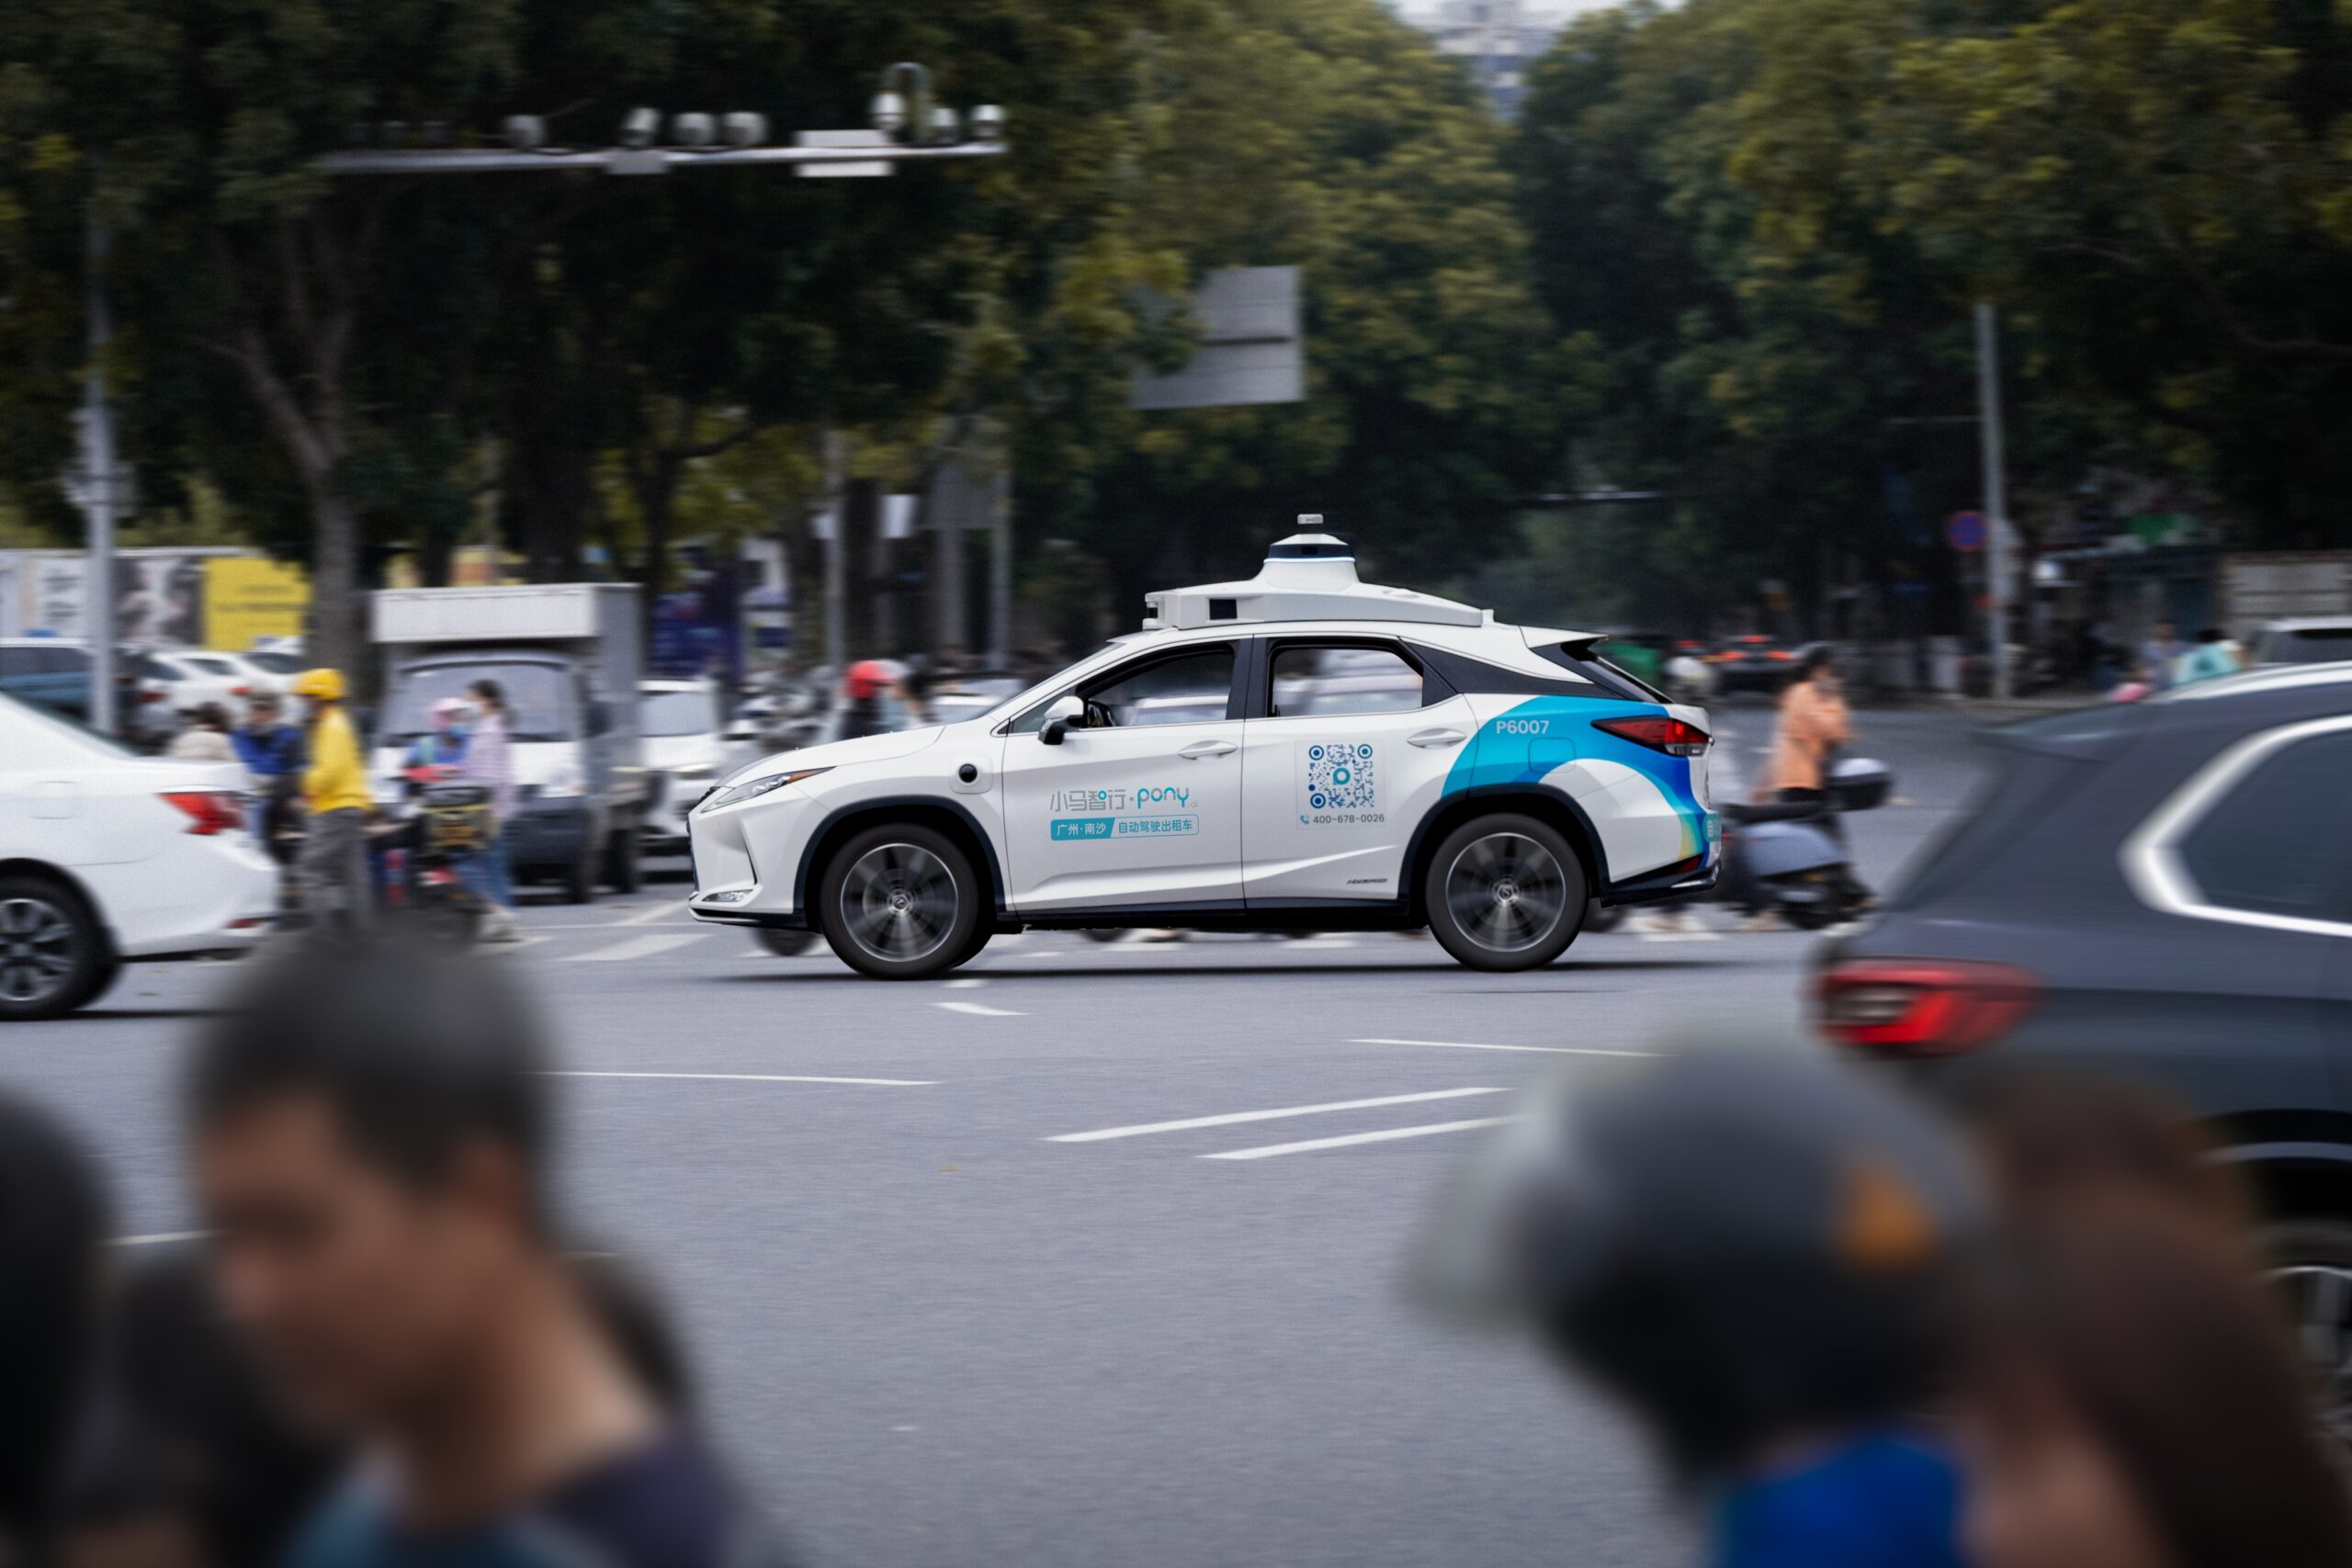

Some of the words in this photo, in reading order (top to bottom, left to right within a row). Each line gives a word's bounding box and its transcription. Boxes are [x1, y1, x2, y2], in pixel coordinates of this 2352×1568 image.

[1496, 719, 1550, 734] P6007
[1118, 818, 1193, 834] 自动驾驶出租车
[1313, 813, 1385, 824] 400-678-0026
